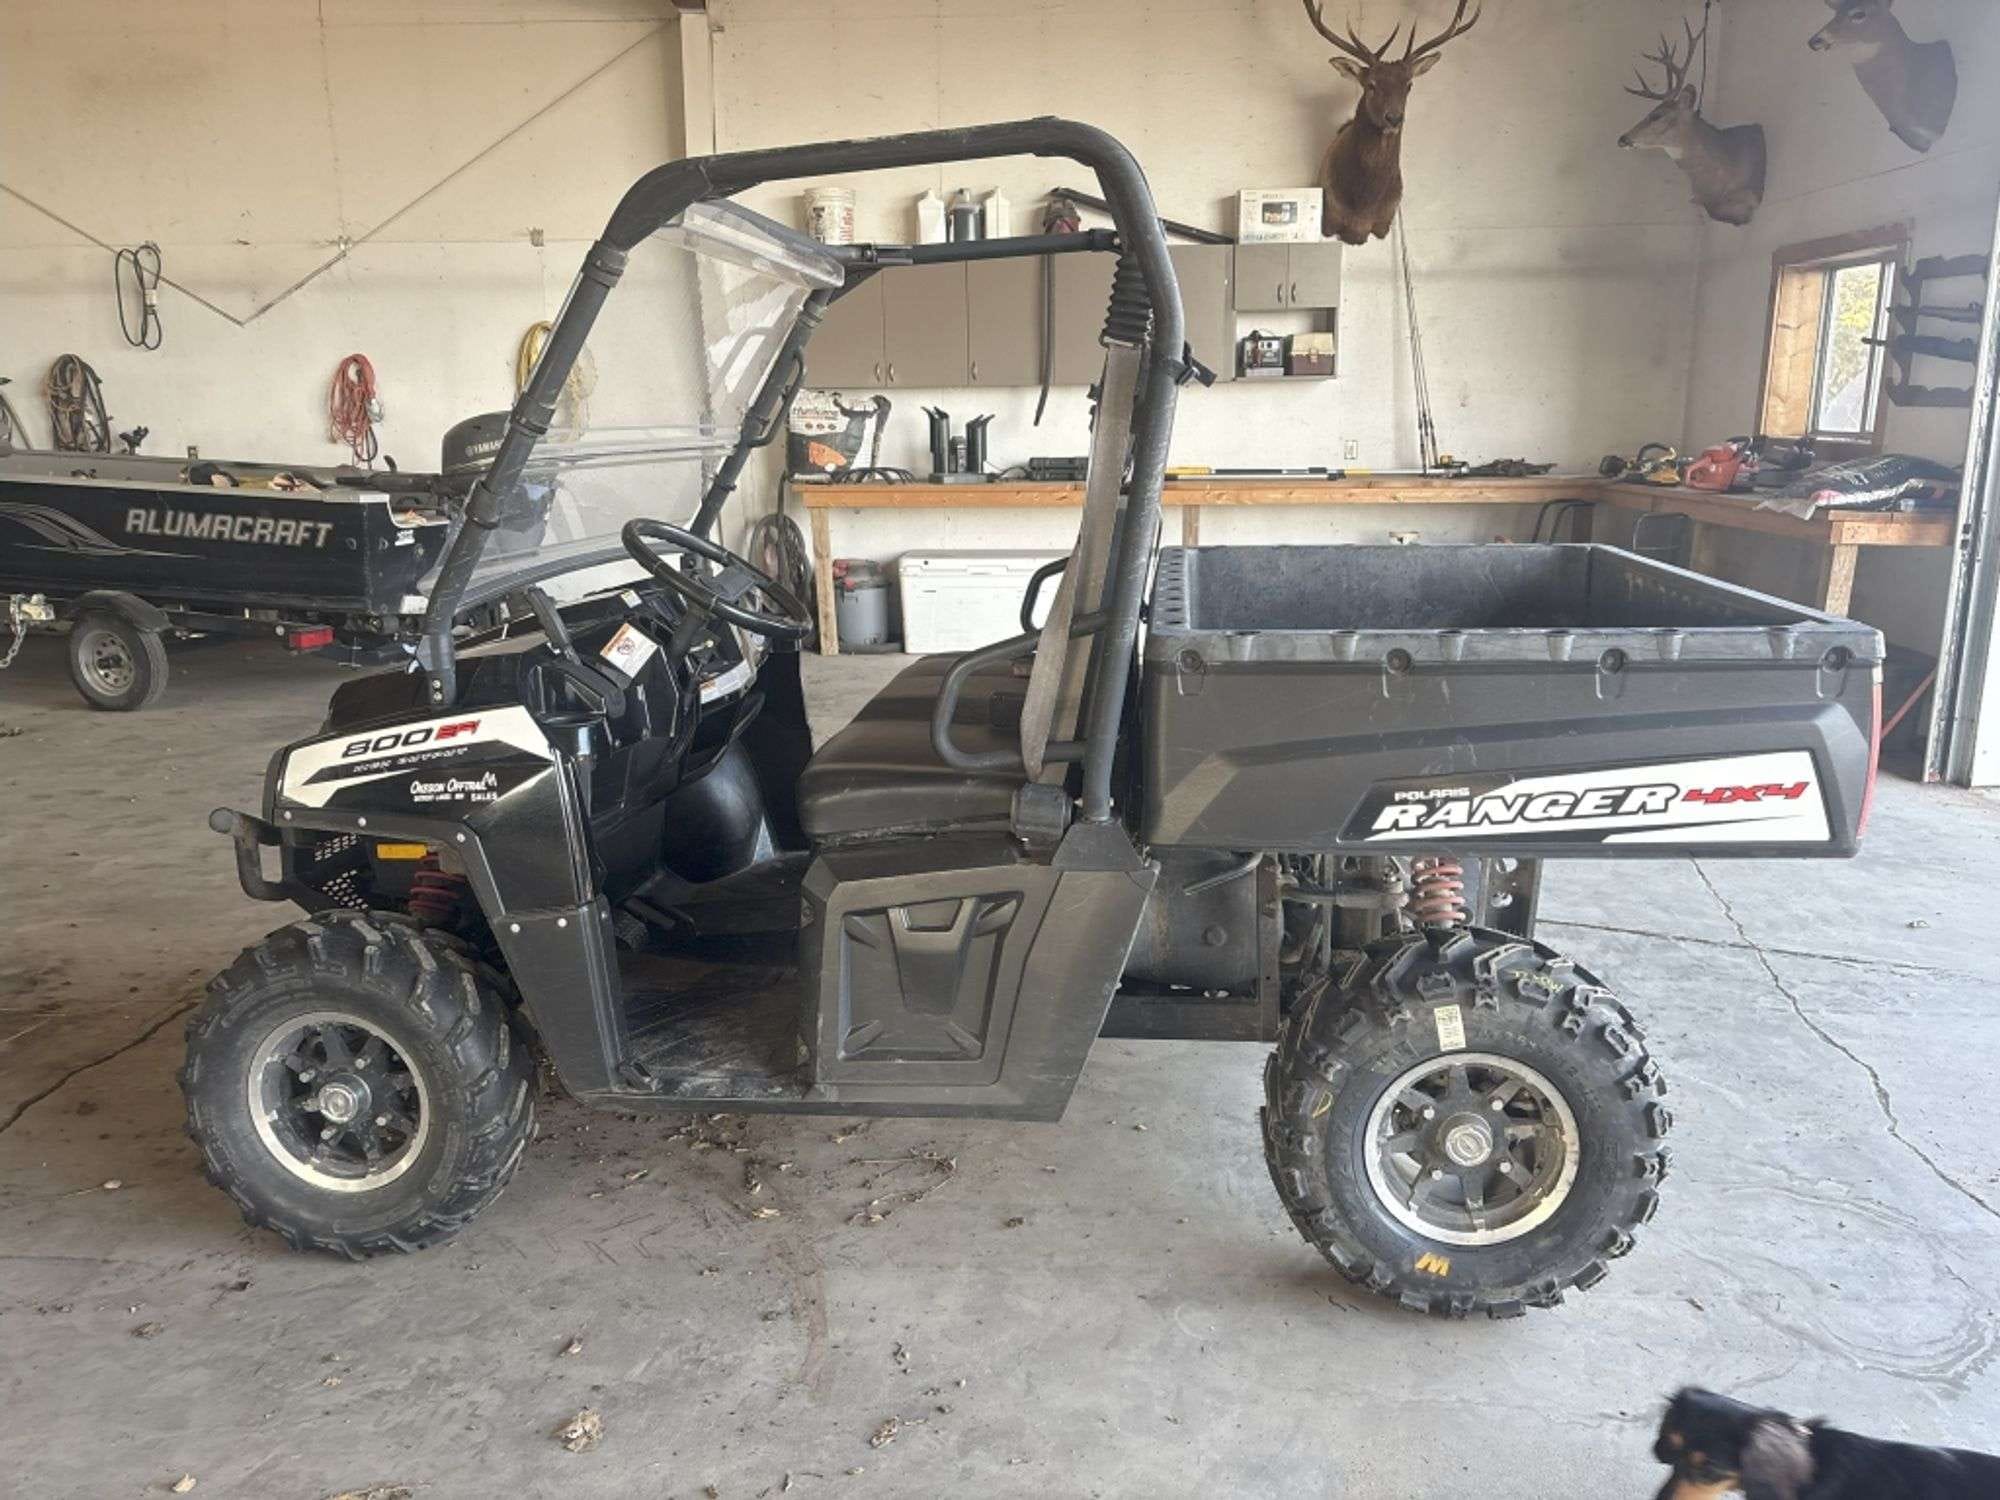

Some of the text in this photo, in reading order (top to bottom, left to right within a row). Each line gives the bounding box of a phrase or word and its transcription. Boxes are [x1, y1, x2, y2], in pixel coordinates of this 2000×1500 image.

[125, 508, 333, 548] ALUMACRAFT
[342, 728, 434, 759] 800
[1370, 783, 1681, 831] RANGER
[1394, 787, 1470, 802] POLARIS
